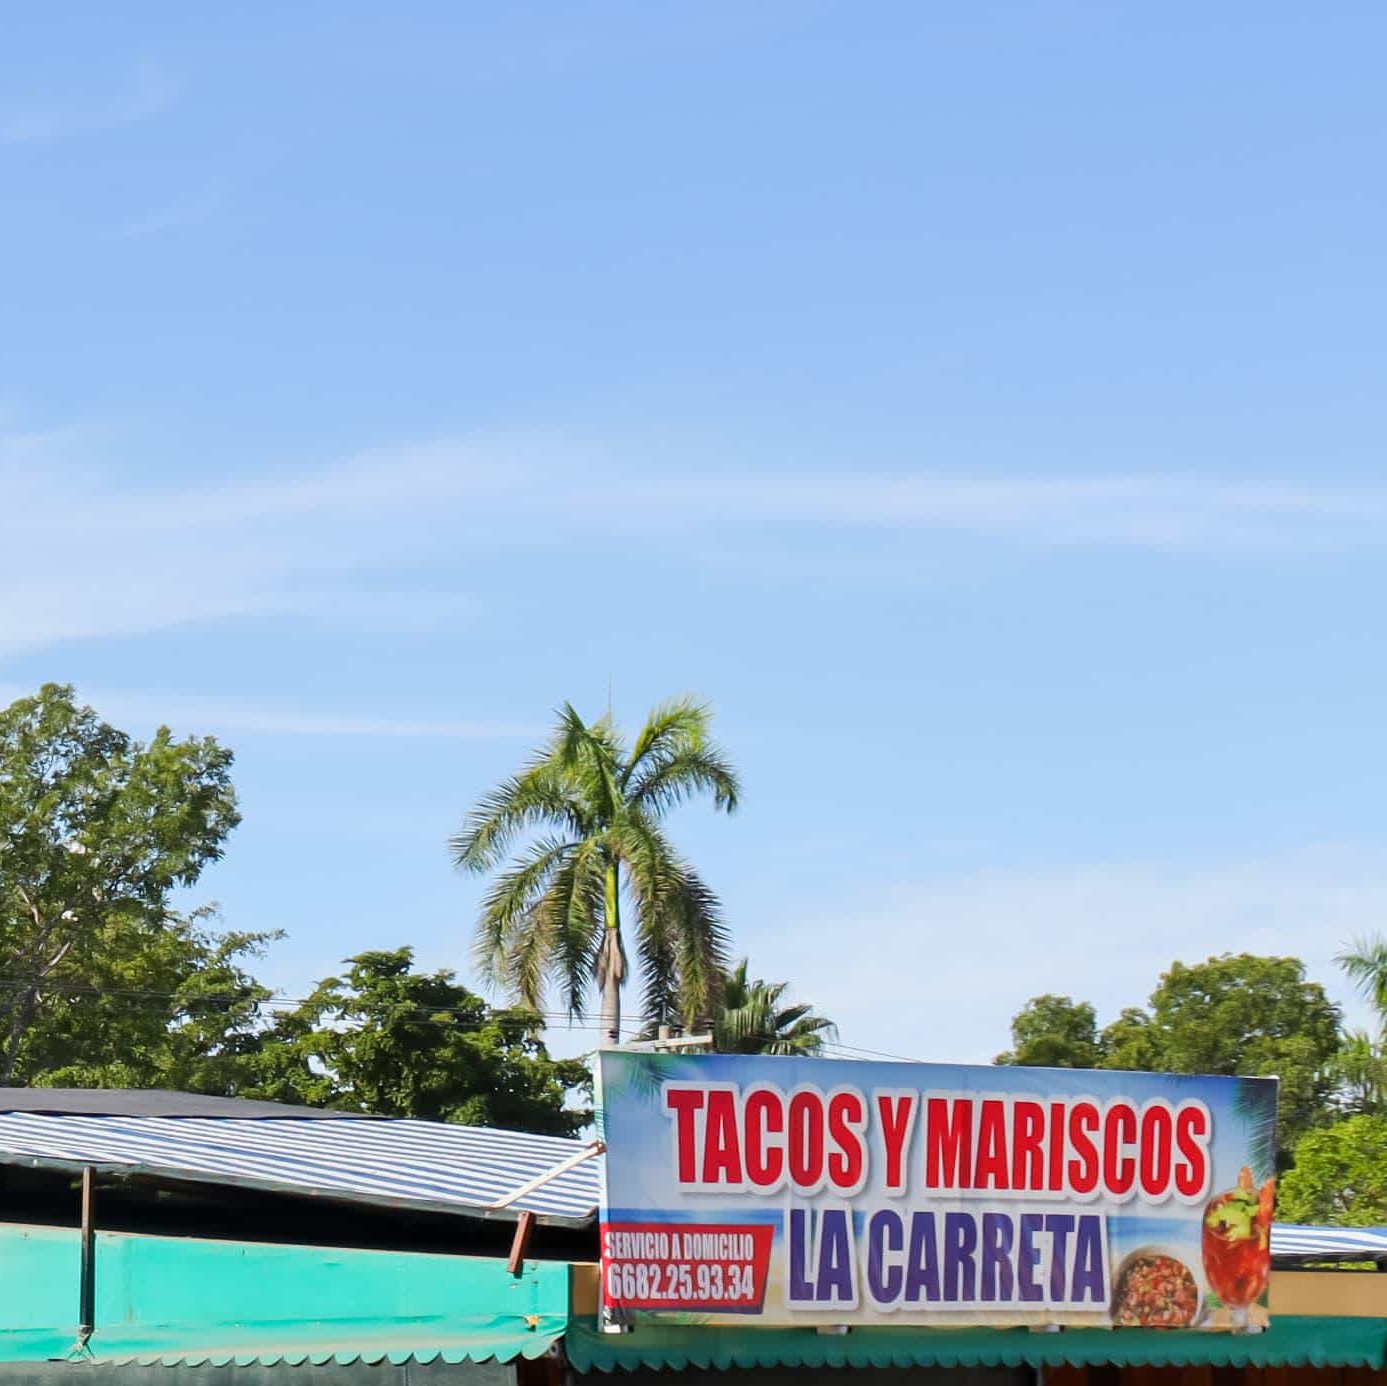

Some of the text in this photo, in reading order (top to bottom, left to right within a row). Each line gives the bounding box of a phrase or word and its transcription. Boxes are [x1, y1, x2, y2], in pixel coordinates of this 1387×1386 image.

[667, 1089, 1206, 1197] TACOS Y MARISCOS
[605, 1231, 754, 1261] SERVICIO A DOMICILIO
[789, 1208, 1106, 1304] LA CARRETA
[607, 1263, 755, 1301] 6682.25.93.34
